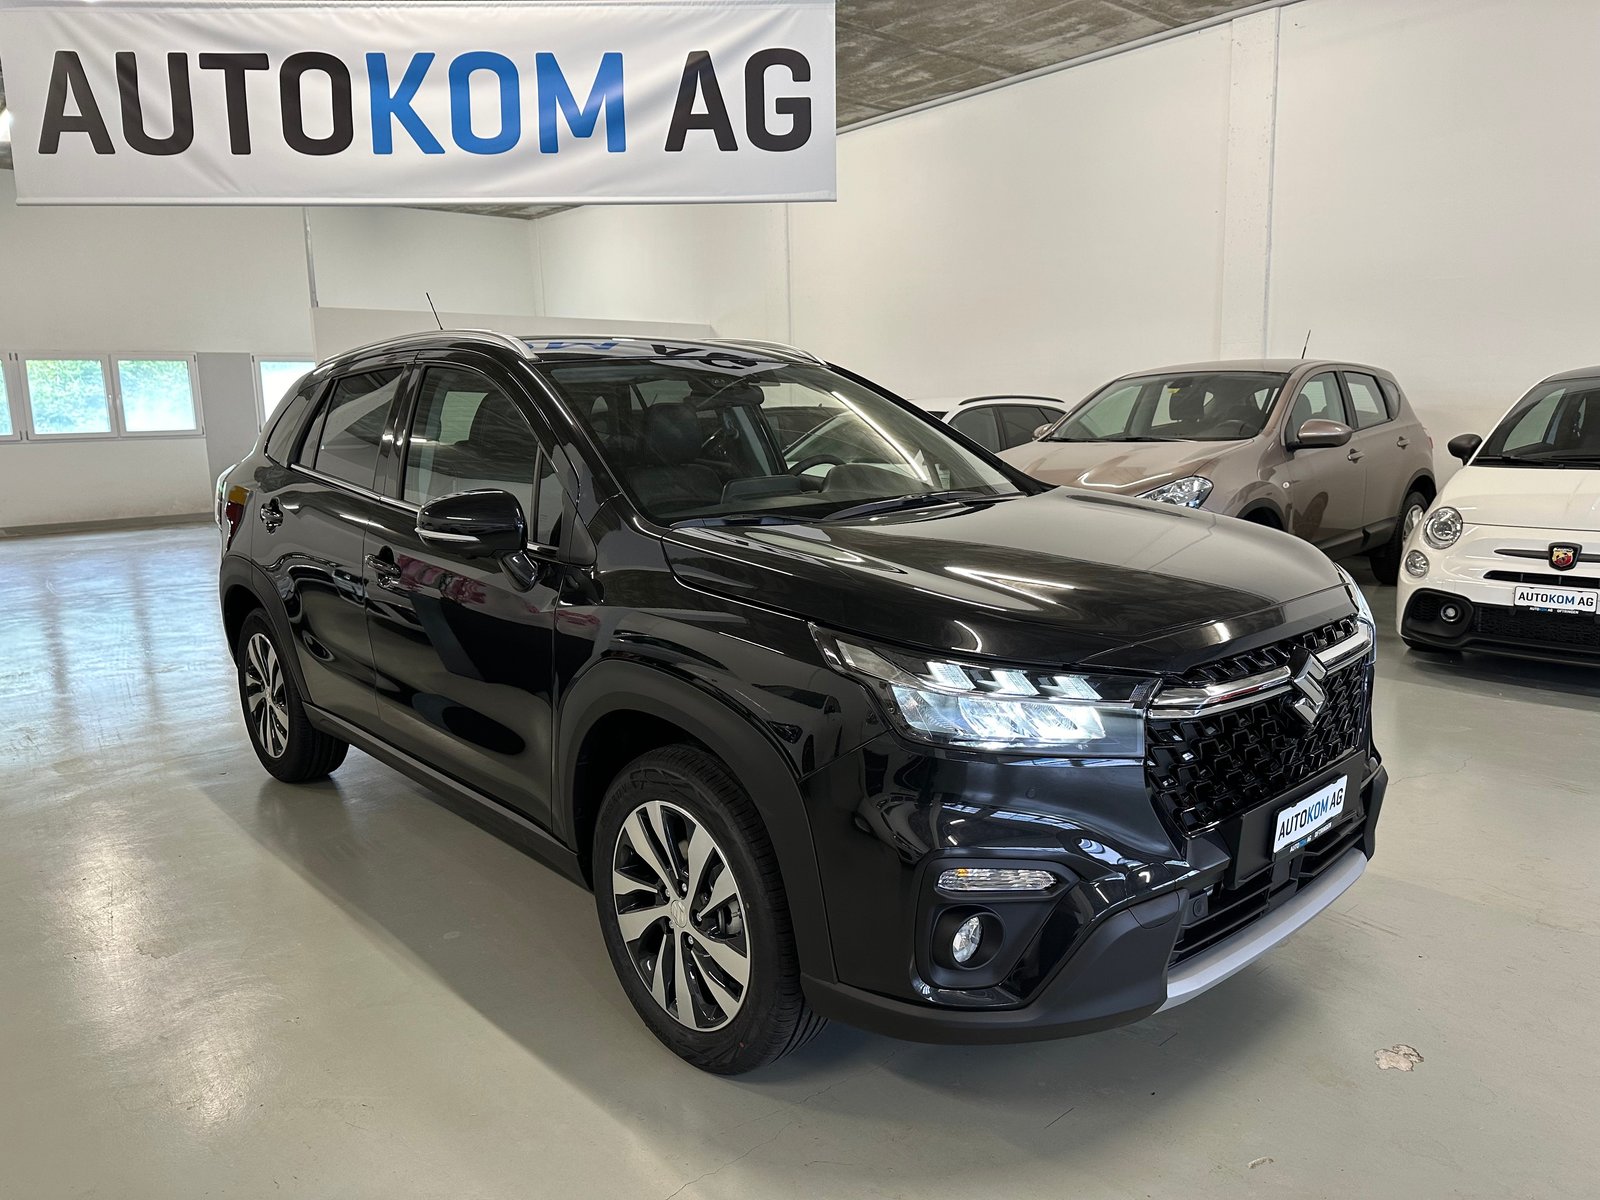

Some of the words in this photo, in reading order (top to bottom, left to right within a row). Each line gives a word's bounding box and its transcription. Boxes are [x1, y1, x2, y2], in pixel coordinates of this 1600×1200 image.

[38, 50, 627, 156] AUTOKOM
[664, 47, 813, 153] AG
[1518, 592, 1575, 605] AUTOKOM
[1577, 596, 1594, 607] AG
[1278, 795, 1329, 841] AUTOKOM
[1329, 788, 1343, 810] AG
